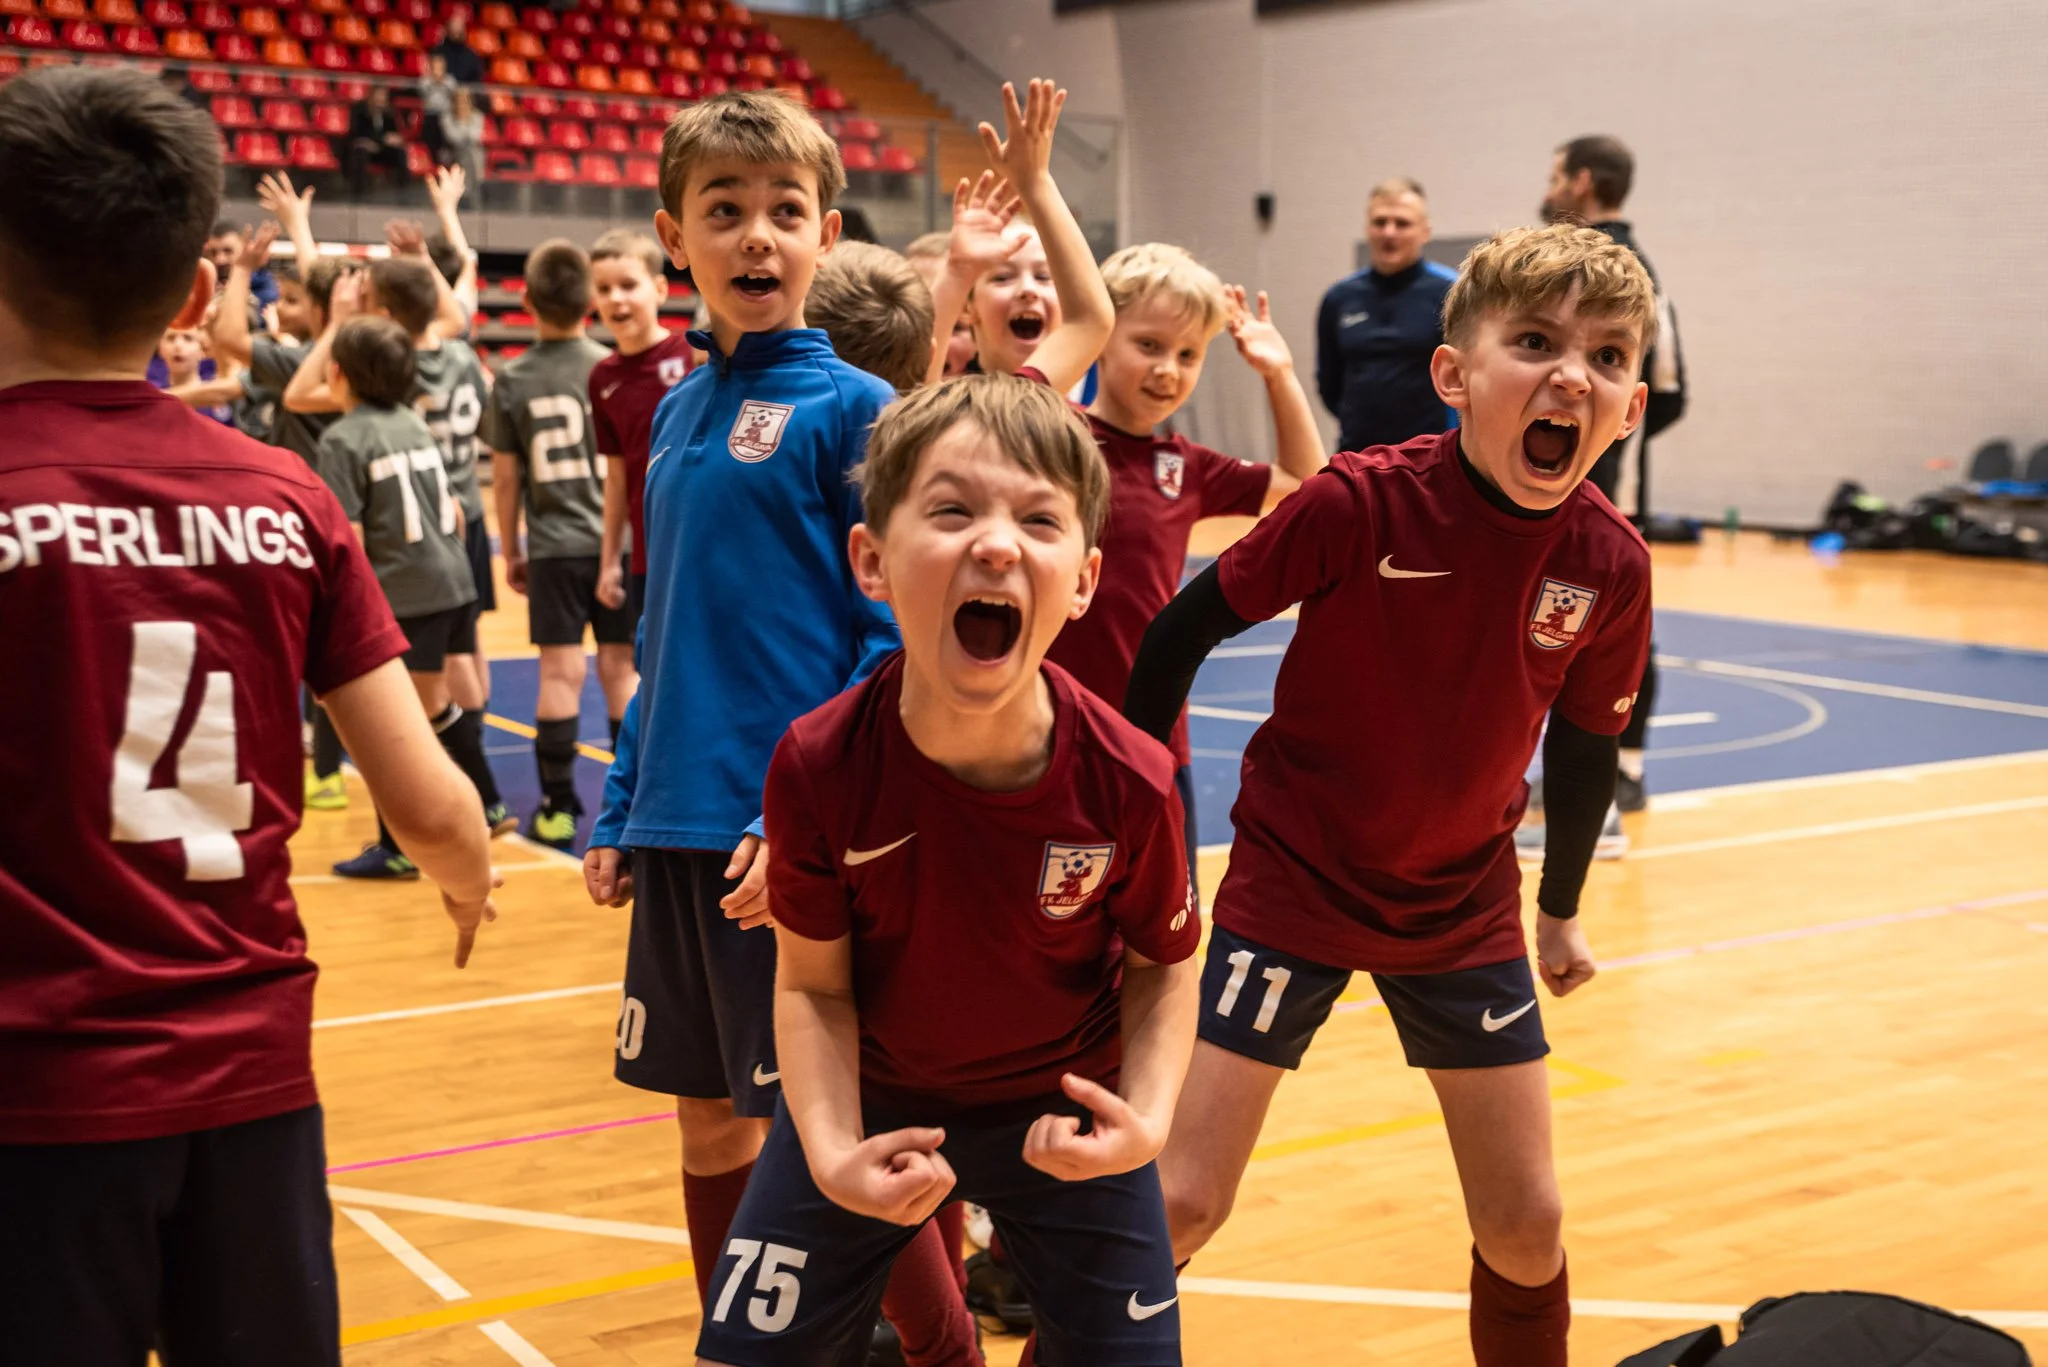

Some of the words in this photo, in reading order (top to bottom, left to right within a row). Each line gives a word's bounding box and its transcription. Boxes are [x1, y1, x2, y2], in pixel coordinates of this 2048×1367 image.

[528, 394, 608, 483] 2
[0, 503, 316, 573] SPERLINGS
[370, 447, 457, 544] 77
[1530, 623, 1543, 632] FK
[1542, 626, 1575, 641] JELGAVA
[110, 621, 254, 881] 4
[616, 996, 647, 1060] 0
[1216, 950, 1292, 1034] 11
[711, 1238, 809, 1333] 75
